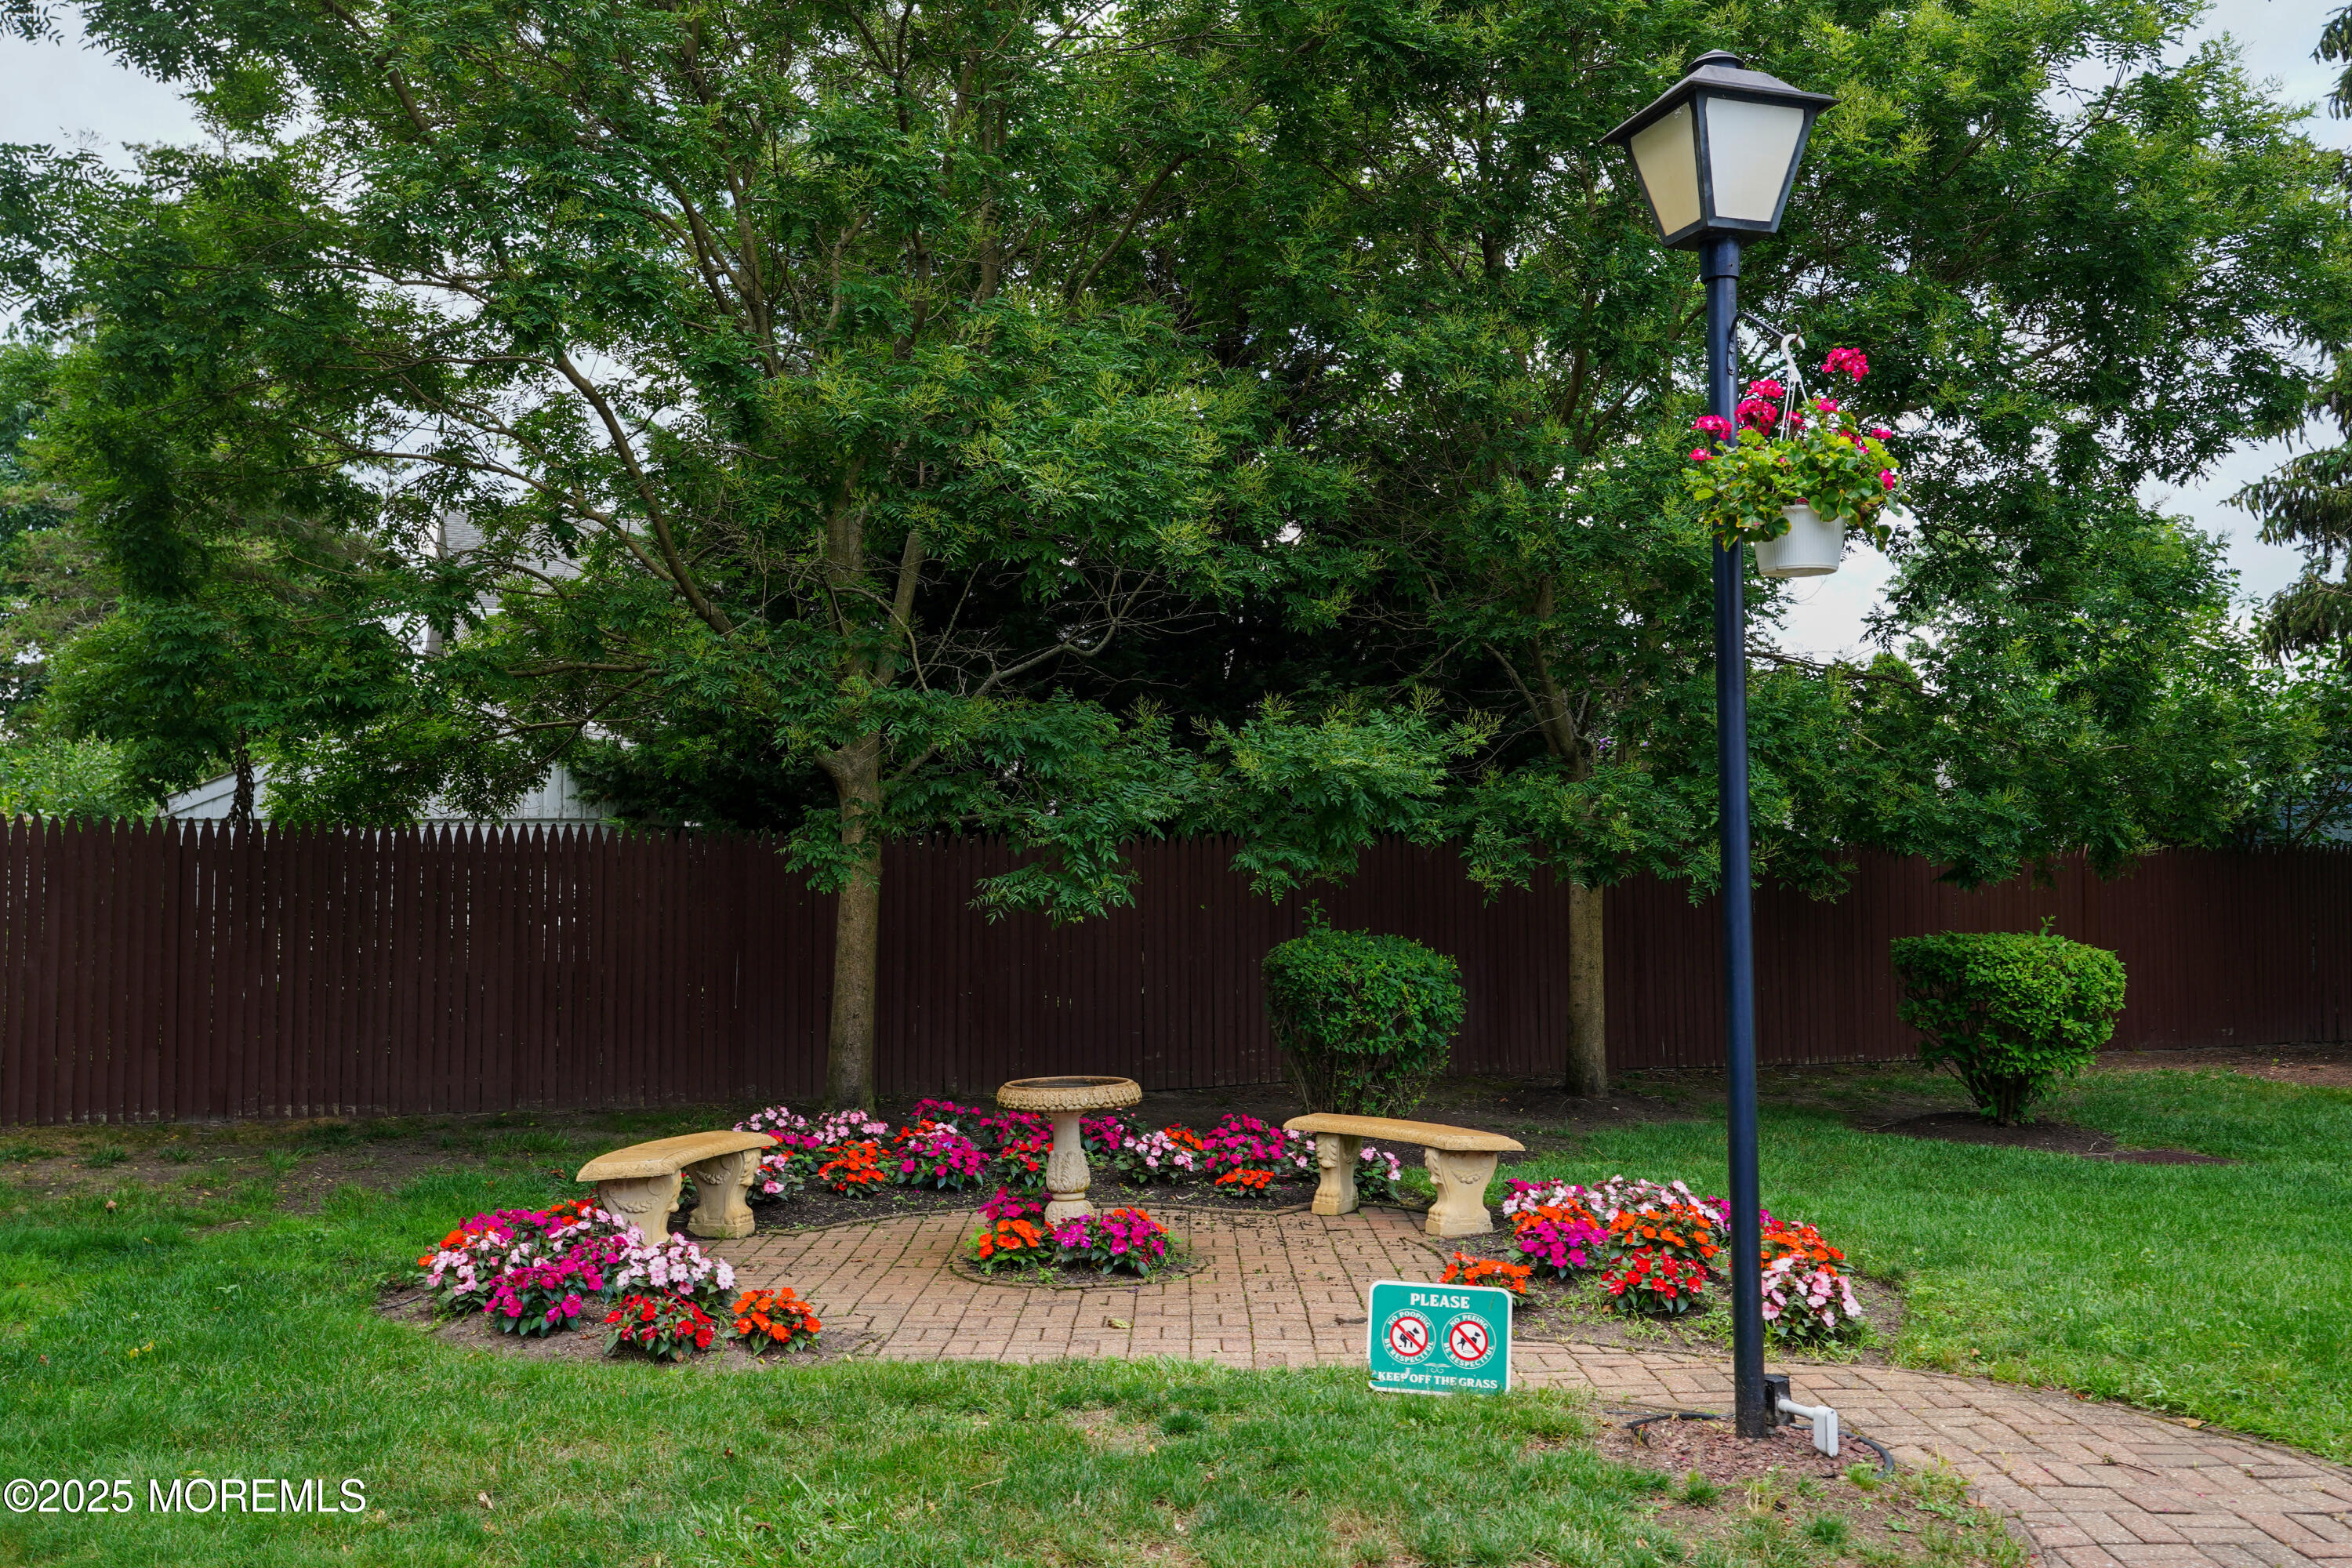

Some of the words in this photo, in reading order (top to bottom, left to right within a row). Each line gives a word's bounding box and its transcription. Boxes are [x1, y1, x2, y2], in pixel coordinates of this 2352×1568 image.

[1410, 1293, 1470, 1309] PLEASE
[1388, 1315, 1398, 1326] NO
[1399, 1311, 1431, 1329] POOPING
[1449, 1318, 1461, 1328] NO
[1462, 1314, 1489, 1330] PEEING
[1384, 1338, 1392, 1350] BE
[1390, 1341, 1434, 1363] RESPECTFUL
[1443, 1341, 1452, 1354] BE
[1449, 1345, 1494, 1367] RESPECTFUL
[1377, 1371, 1408, 1382] KEEP
[1409, 1374, 1431, 1385] OFF
[1433, 1375, 1457, 1386] THE
[1458, 1377, 1498, 1389] GRASS
